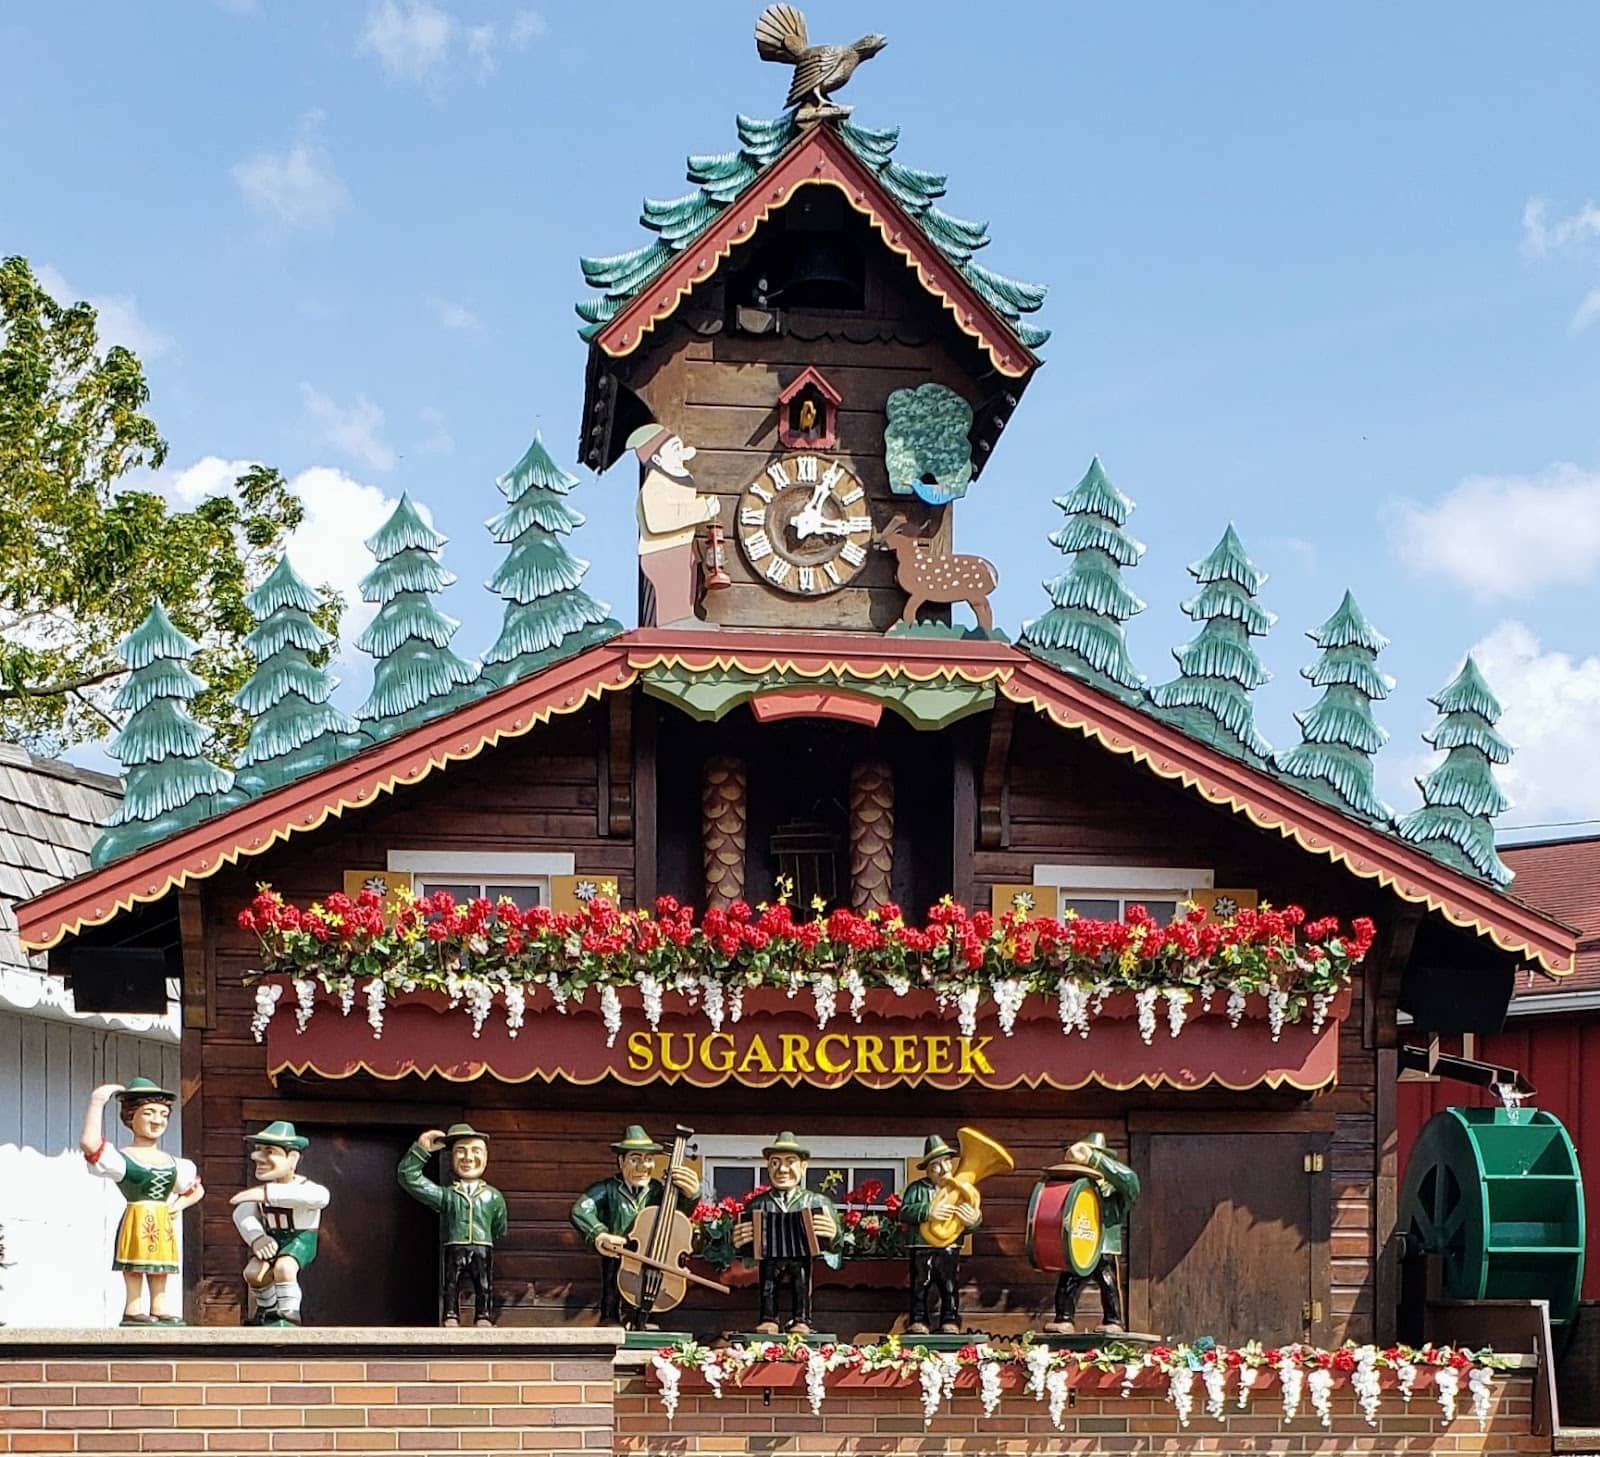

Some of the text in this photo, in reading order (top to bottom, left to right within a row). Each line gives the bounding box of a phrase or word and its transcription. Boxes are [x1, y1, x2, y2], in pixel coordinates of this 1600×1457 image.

[797, 456, 817, 482] XII
[749, 483, 773, 503] X
[628, 1031, 995, 1075] SUGARCREEK
